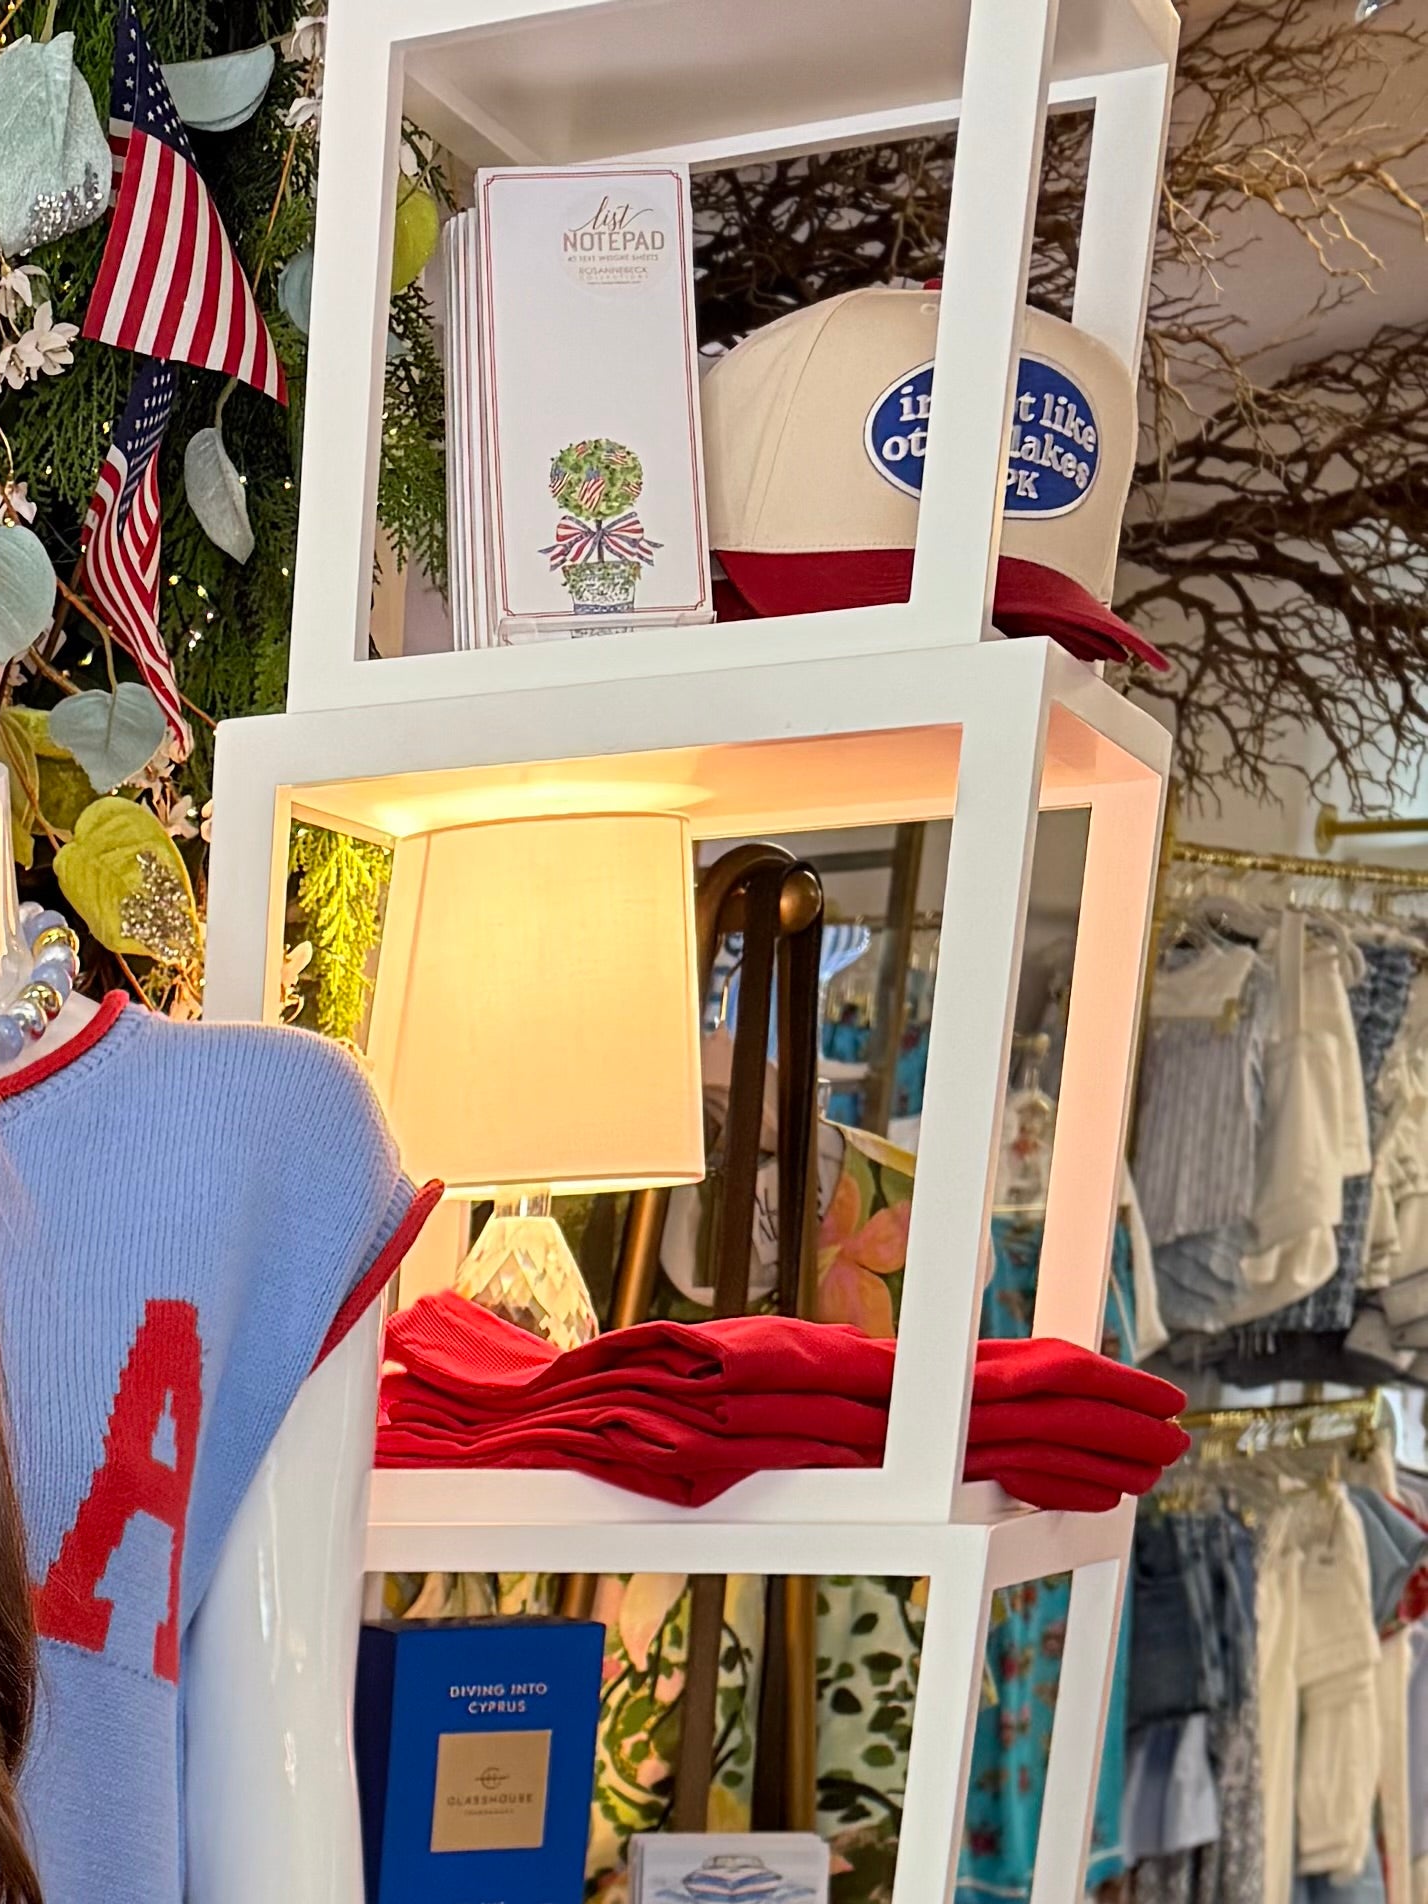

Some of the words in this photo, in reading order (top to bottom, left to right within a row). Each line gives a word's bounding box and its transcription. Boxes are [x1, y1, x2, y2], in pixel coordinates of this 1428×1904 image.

[568, 195, 654, 232] list
[563, 231, 665, 252] NOTEPAD
[1039, 393, 1097, 452] like
[450, 1683, 505, 1698] DIVING
[510, 1682, 548, 1696] INTO
[468, 1700, 526, 1714] CYPRUS
[447, 1792, 533, 1807] GLASSHOUSE
